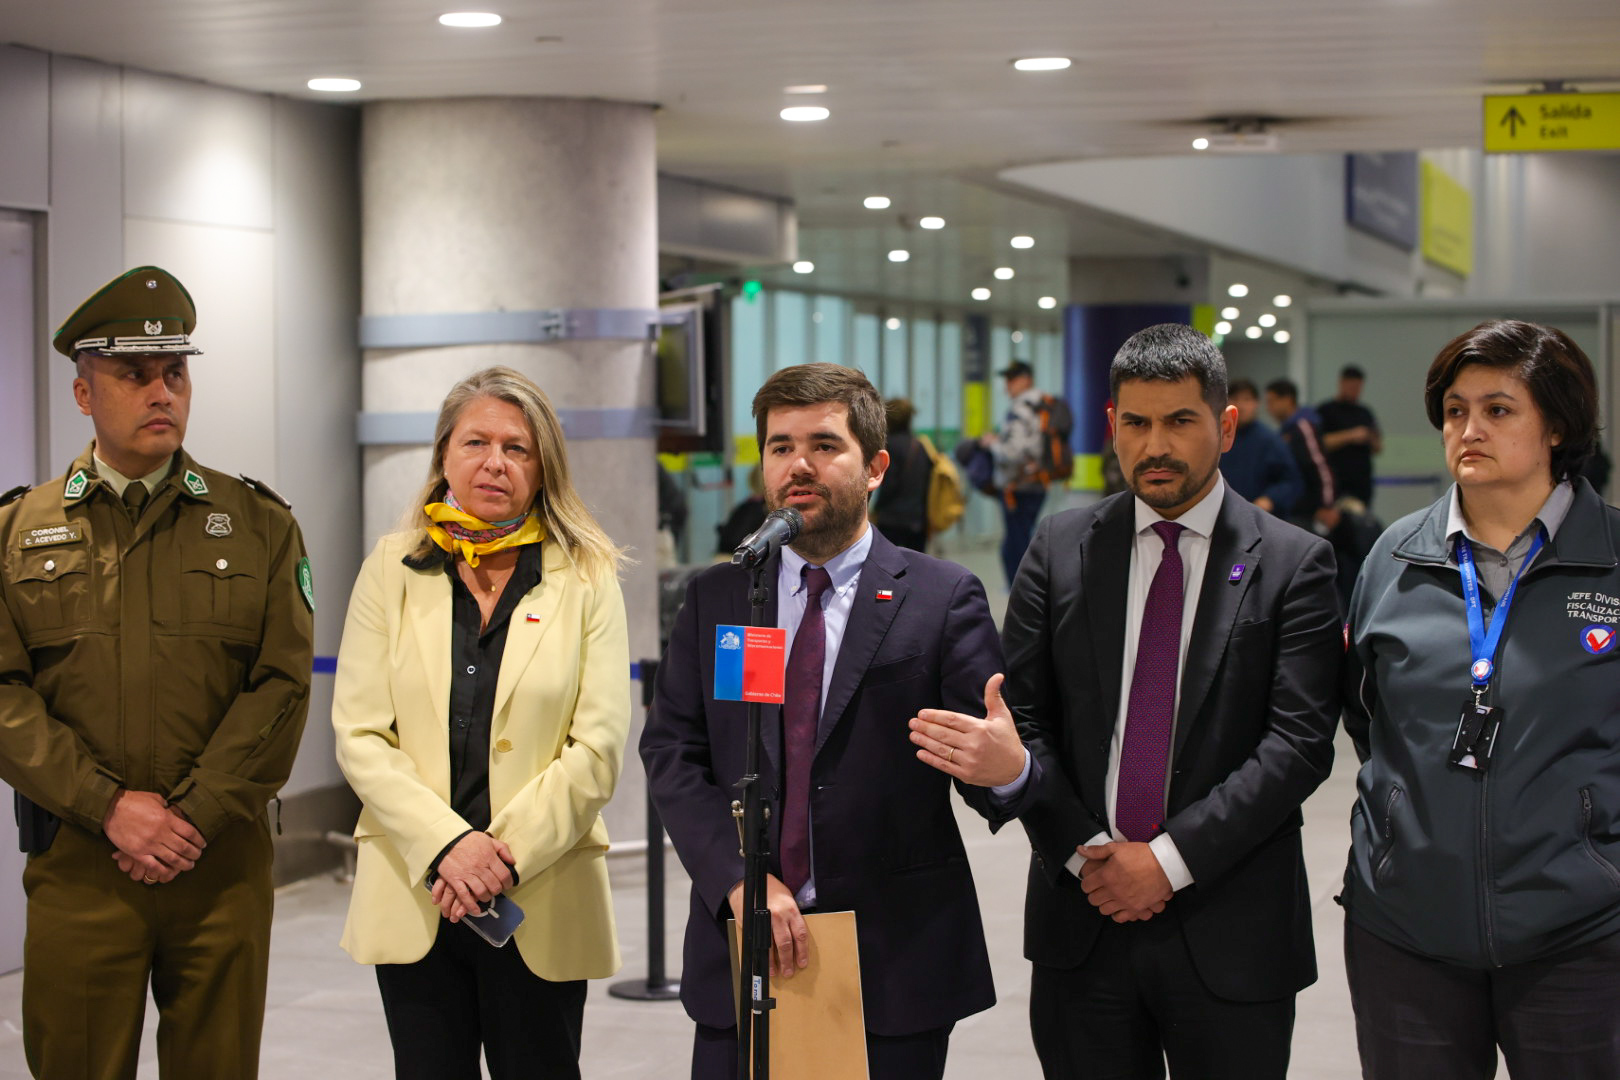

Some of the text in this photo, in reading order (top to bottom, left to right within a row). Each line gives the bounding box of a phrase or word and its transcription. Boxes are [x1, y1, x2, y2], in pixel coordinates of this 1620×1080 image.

[1540, 104, 1592, 119] Salida
[1540, 125, 1568, 138] Exit
[31, 526, 69, 537] CORONEL
[35, 534, 67, 544] ACEVEDO
[1567, 592, 1592, 600] JEFE
